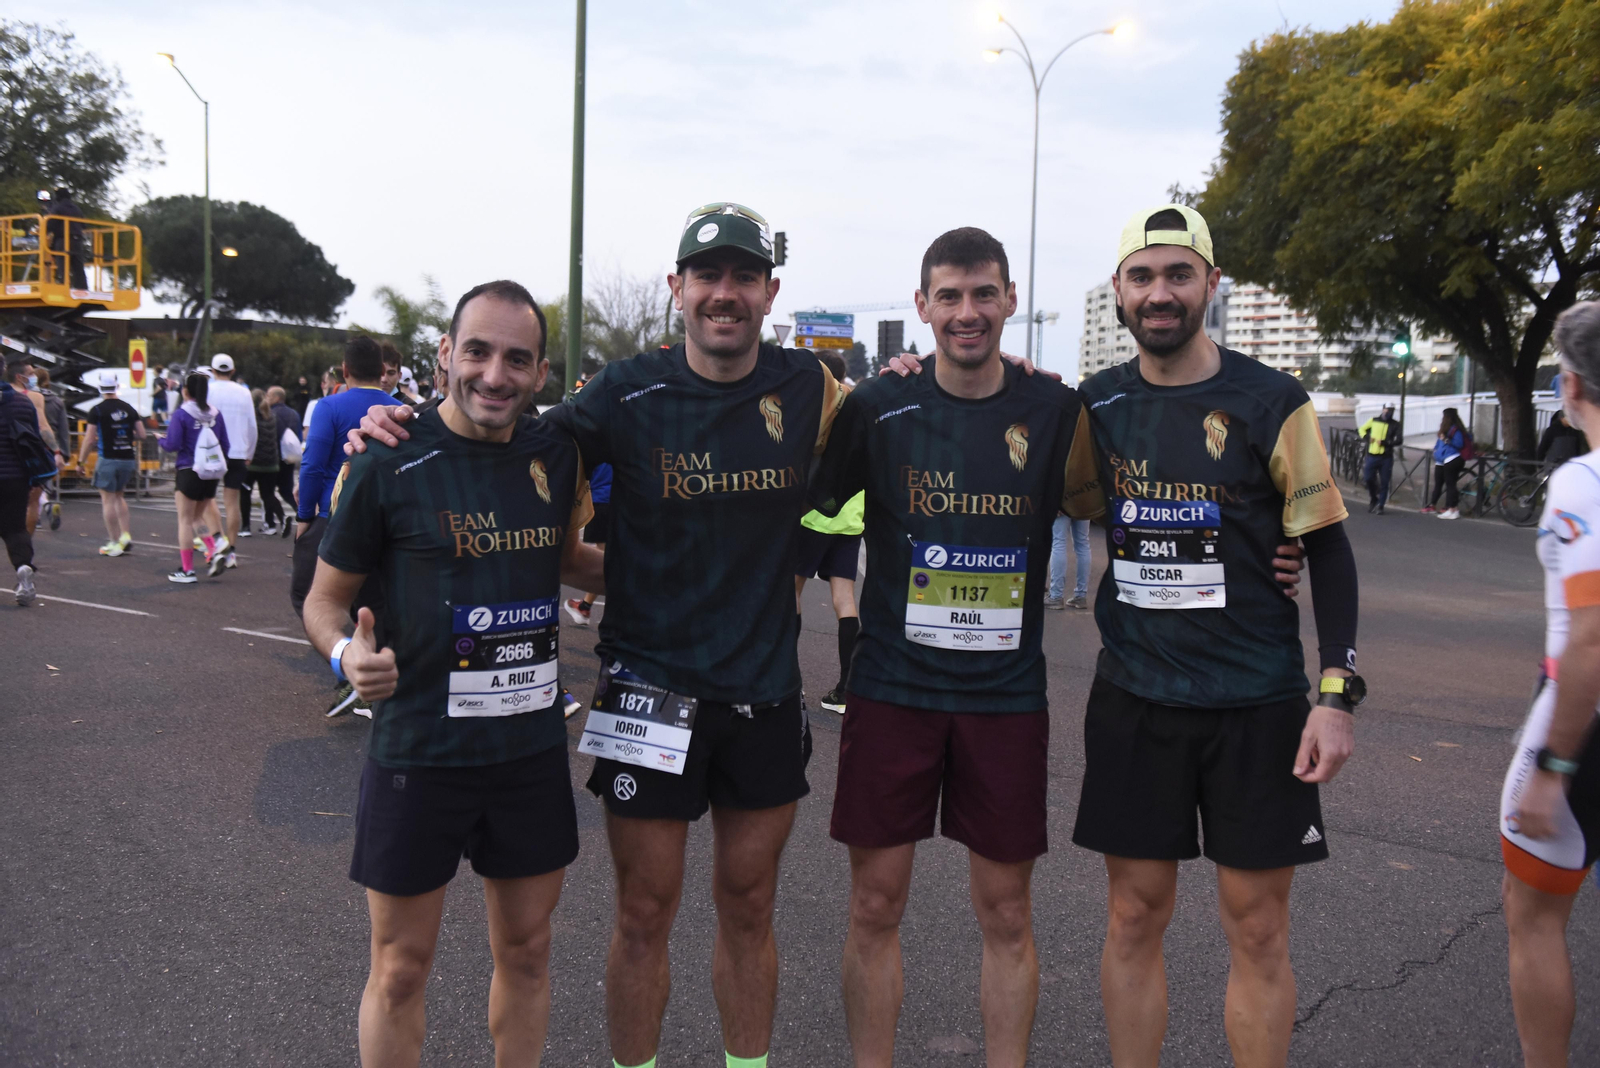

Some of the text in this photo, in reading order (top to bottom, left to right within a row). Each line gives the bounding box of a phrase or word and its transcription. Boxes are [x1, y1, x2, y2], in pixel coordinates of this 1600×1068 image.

[651, 447, 712, 477] TEAM
[899, 464, 955, 493] TEAM
[1140, 506, 1205, 522] ZURICH
[436, 510, 498, 538] TEAM
[1140, 540, 1178, 557] 2941
[951, 552, 1016, 568] ZURICH
[1140, 565, 1183, 581] ÓSCAR
[950, 585, 989, 602] 1137
[496, 604, 552, 626] ZURICH
[950, 610, 984, 625] RAÚL
[495, 642, 534, 663] 2666
[490, 670, 536, 688] A. RUIZ
[619, 692, 655, 714] 1871
[614, 719, 648, 738] IORDI
